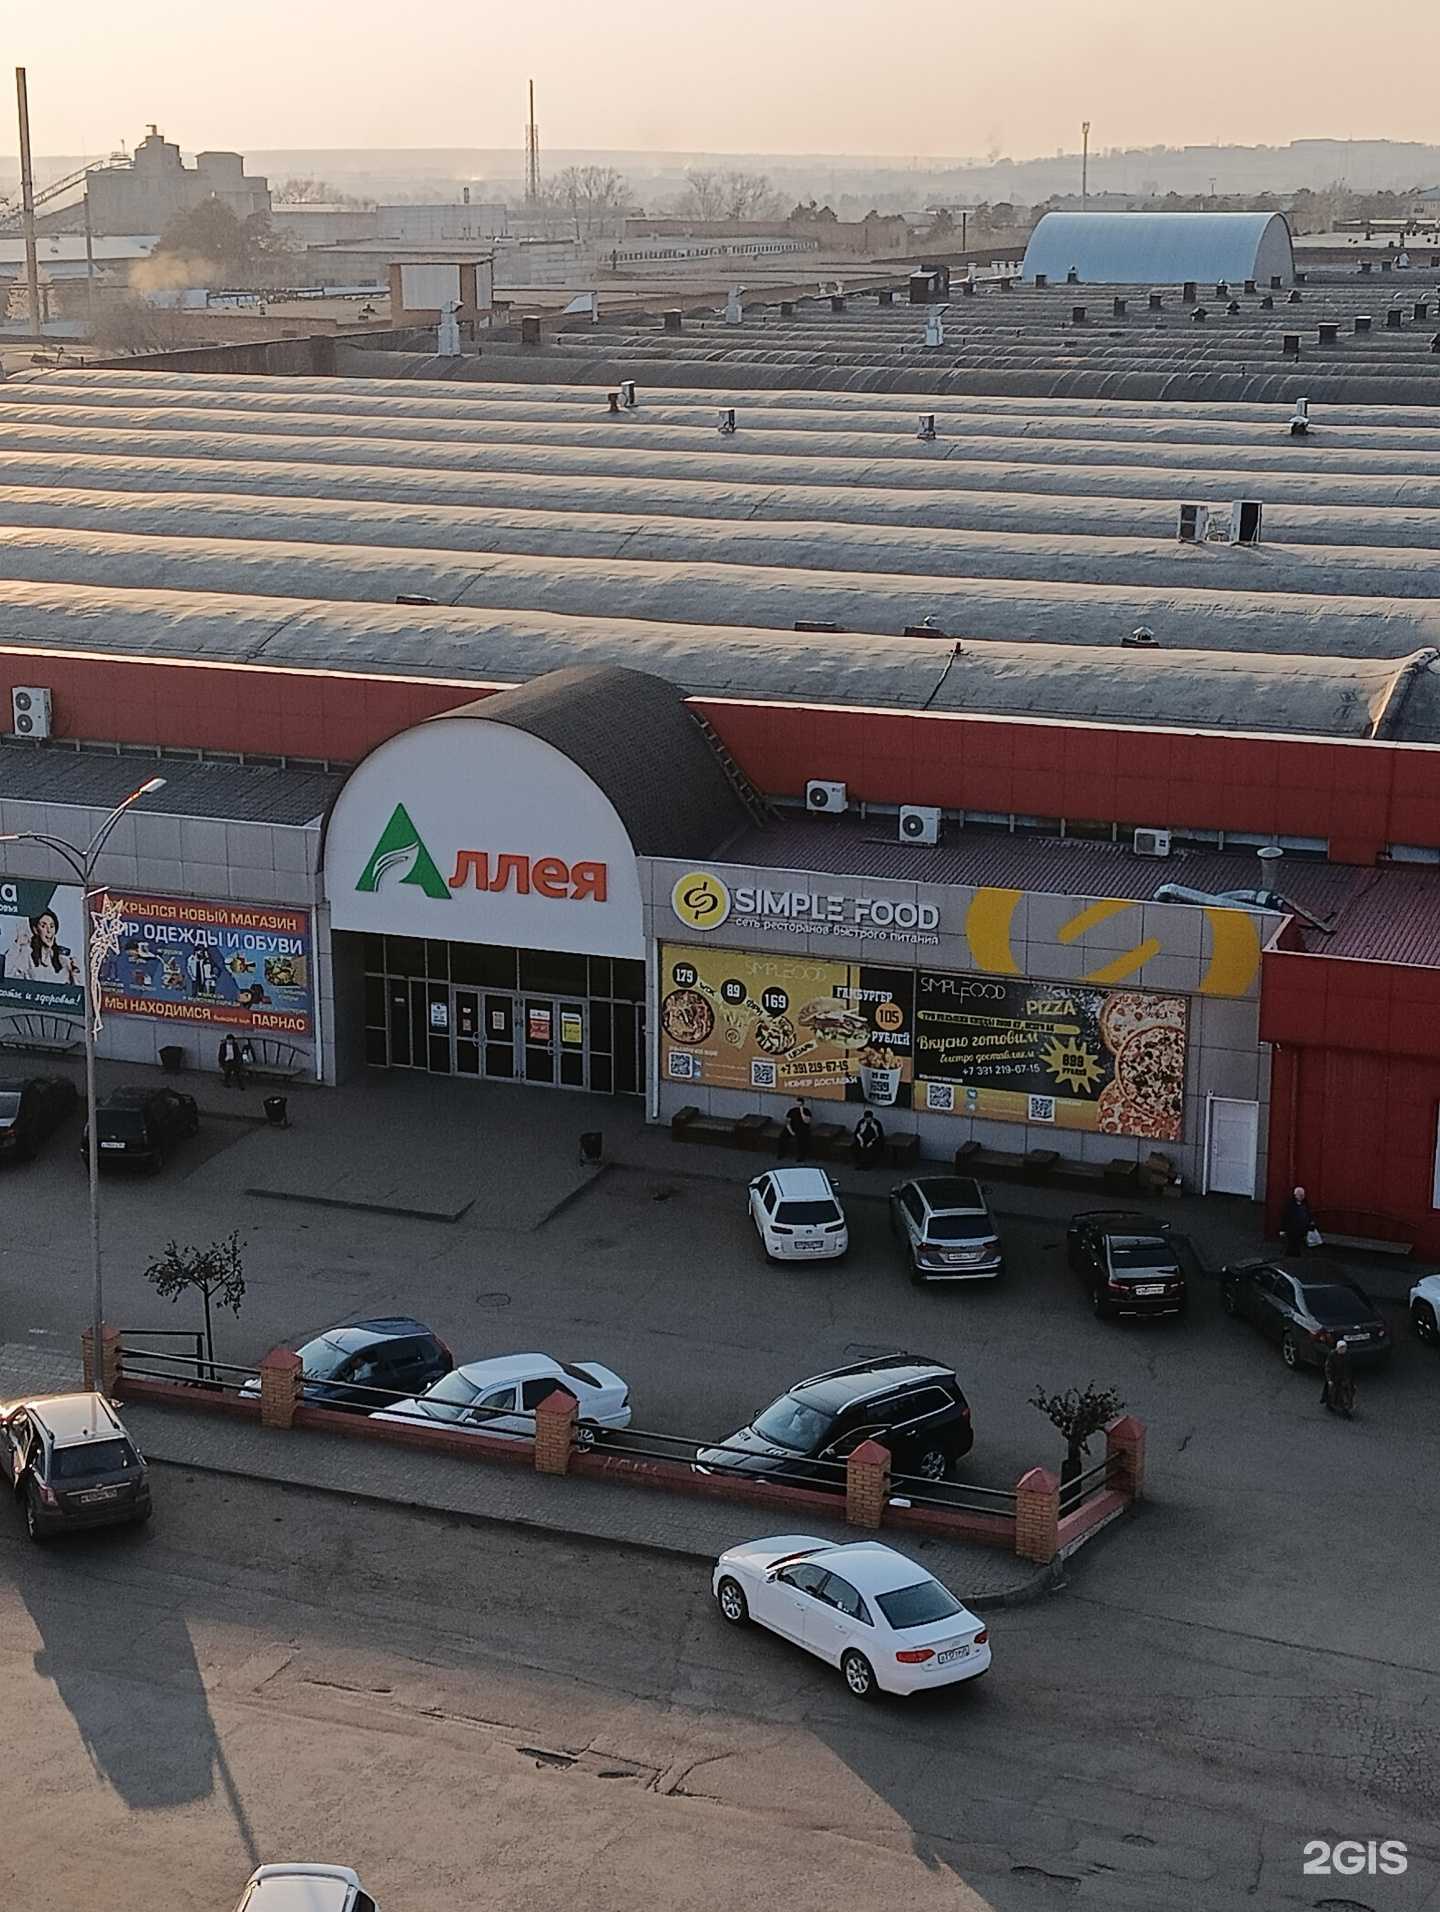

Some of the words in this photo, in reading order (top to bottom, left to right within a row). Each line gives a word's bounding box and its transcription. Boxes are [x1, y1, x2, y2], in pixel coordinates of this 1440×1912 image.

[355, 801, 607, 903] Аллея
[110, 901, 177, 918] КРЫЛСЯ
[179, 908, 228, 925] НОВЫЙ
[231, 913, 297, 931] МАГАЗИН
[734, 887, 844, 922] SIMPLE
[855, 897, 941, 930] FOOD
[144, 924, 223, 948] ОДЕЖДЫ
[227, 934, 240, 948] И
[244, 935, 303, 955] ОБУВИ
[735, 917, 761, 930] сеть
[763, 920, 829, 937] ресторанов
[833, 925, 886, 943] быстрого
[890, 932, 939, 946] питания
[726, 984, 741, 998] 89
[765, 993, 787, 1009] 169
[105, 997, 127, 1011] МЫ
[130, 1000, 211, 1021] НАХОДИМСЯ
[252, 1013, 305, 1032] ПАРНАС
[879, 1008, 899, 1024] 105
[1026, 998, 1077, 1016] PIZZA
[871, 1030, 911, 1046] РУБЛЕЙ
[917, 1034, 969, 1053] Вкусно
[972, 1030, 1039, 1047] готовим
[962, 1066, 974, 1077] +7
